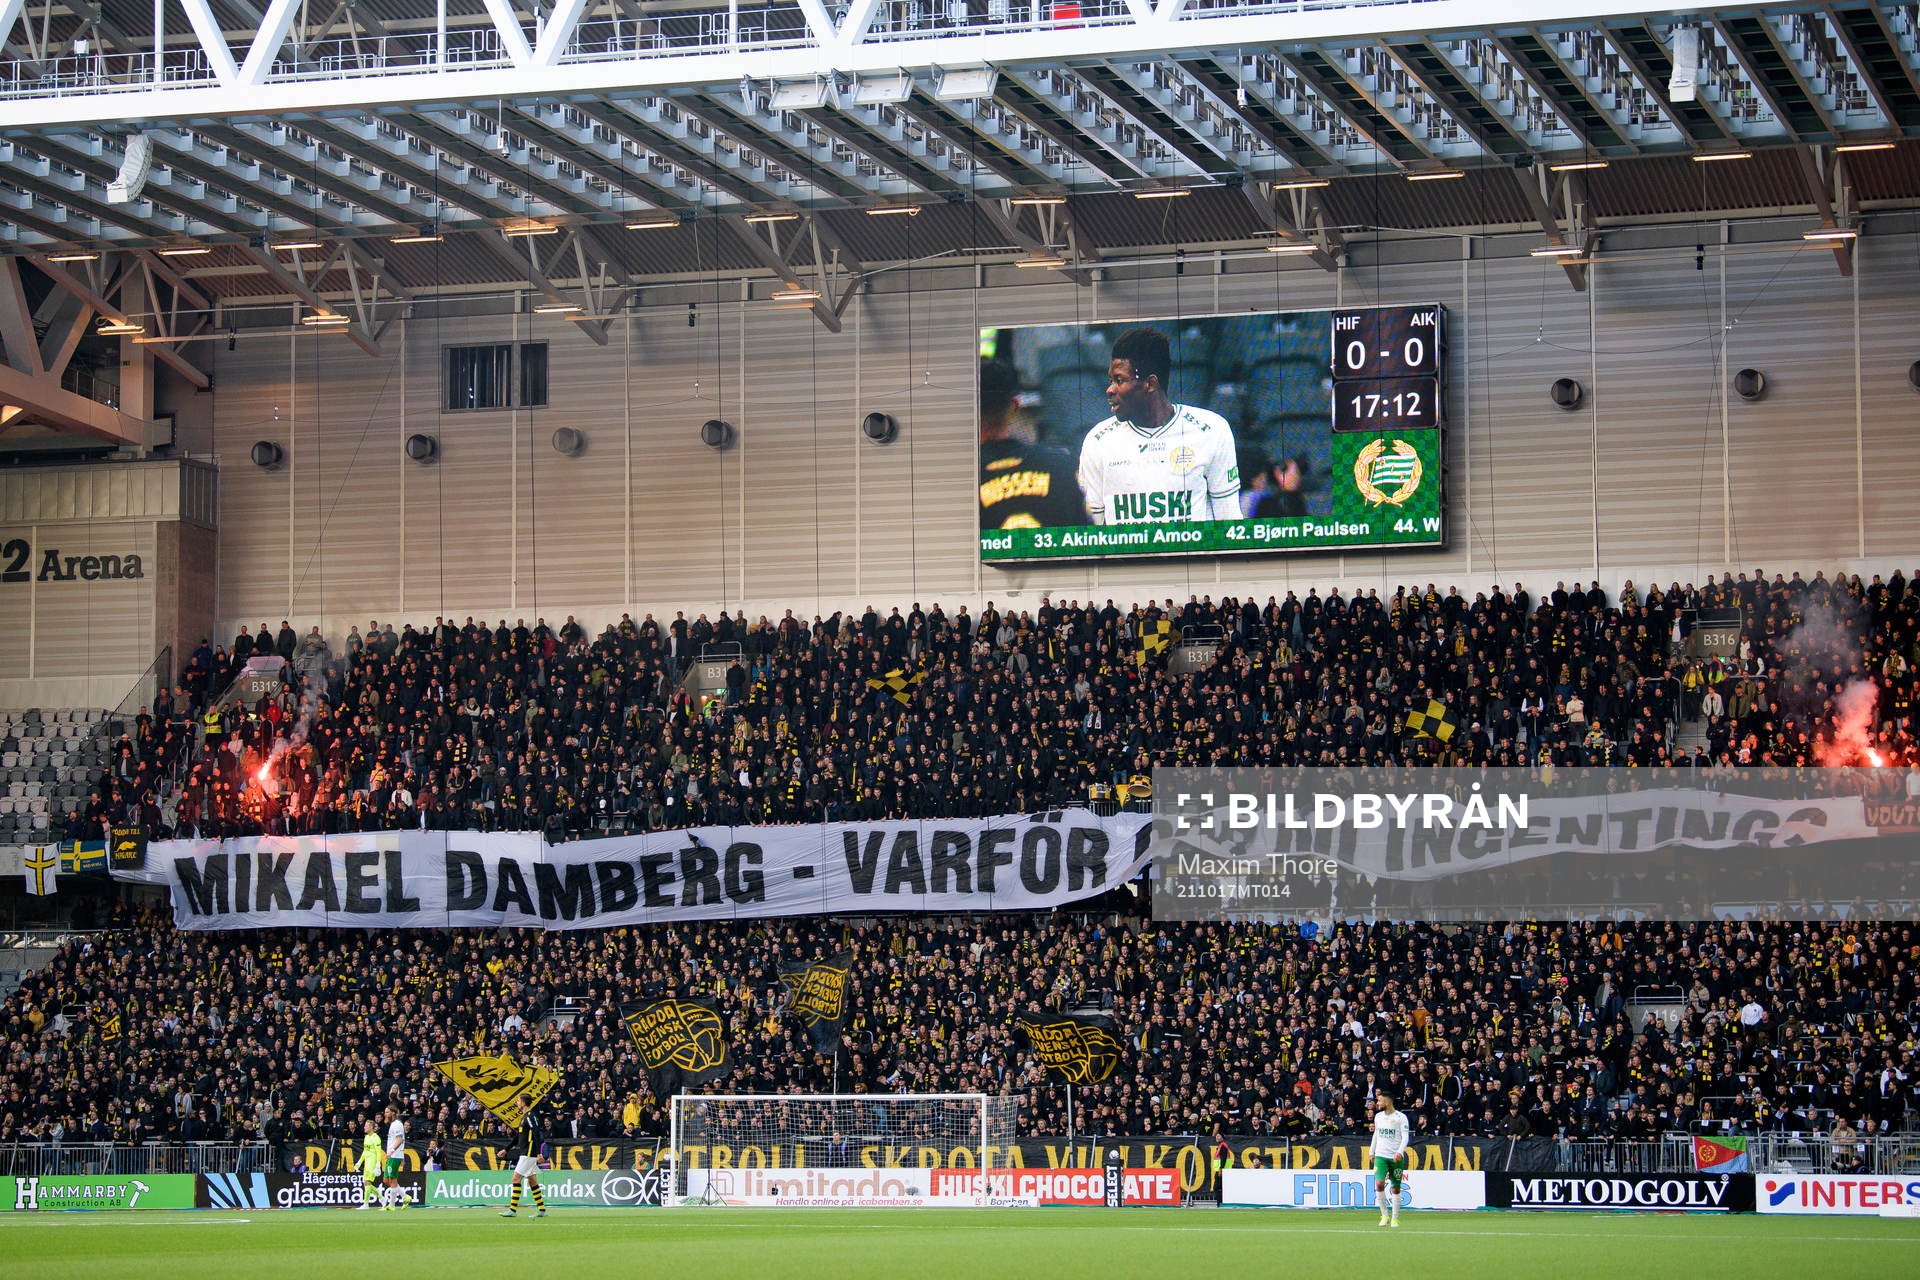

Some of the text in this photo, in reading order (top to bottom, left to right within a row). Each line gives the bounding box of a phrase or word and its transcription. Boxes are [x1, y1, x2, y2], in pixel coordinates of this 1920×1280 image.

[1336, 313, 1435, 331] HIF AIK
[1346, 340, 1366, 370] 0
[1404, 338, 1424, 367] 0
[1351, 392, 1422, 419] 17:12
[1114, 490, 1192, 521] HUSKI
[981, 517, 1440, 549] med 33. Akinkunmi Amoo 42. Bjørn Paulsen 44. W
[37, 550, 144, 581] Arena
[1703, 633, 1735, 646] B316
[707, 667, 728, 679] B31
[1867, 804, 1920, 826] YOUT
[173, 850, 419, 915] MIKAEL
[446, 841, 765, 921] DAMBERG
[793, 865, 814, 878] -
[843, 809, 1110, 895] VARFÖR
[637, 1020, 684, 1050] SVENSK
[645, 1033, 687, 1062] FOTBOLL
[1040, 1048, 1087, 1063] OTBOLL
[15, 1177, 128, 1209] HAMMARBY
[303, 1173, 366, 1187] Hägersten
[745, 1170, 905, 1197] limitado
[938, 1174, 1173, 1200] HUSKI CHOCOATE
[1106, 1165, 1119, 1208] SELECT
[1511, 1178, 1729, 1206] METODGOLV
[776, 1197, 924, 1208] Handla online på icabomben.se
